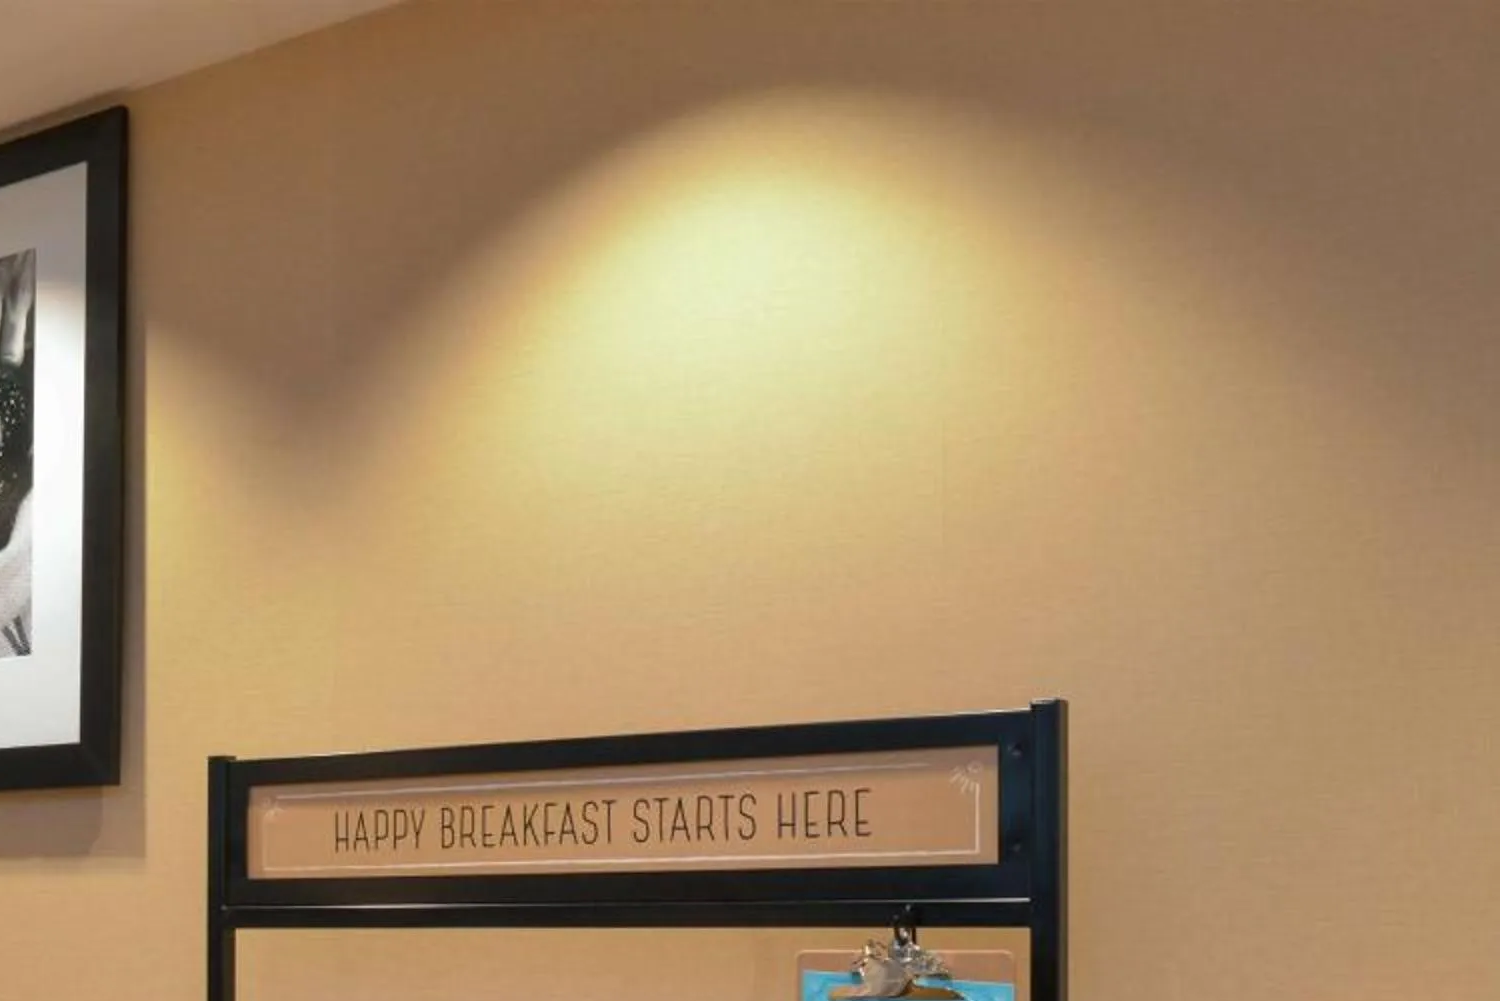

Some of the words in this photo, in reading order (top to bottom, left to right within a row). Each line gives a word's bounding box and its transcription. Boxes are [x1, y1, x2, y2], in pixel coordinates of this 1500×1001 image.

[334, 808, 426, 853] HAPPY
[440, 798, 618, 849] BREAKFAST
[632, 793, 758, 844] STARTS
[777, 787, 873, 840] HERE
